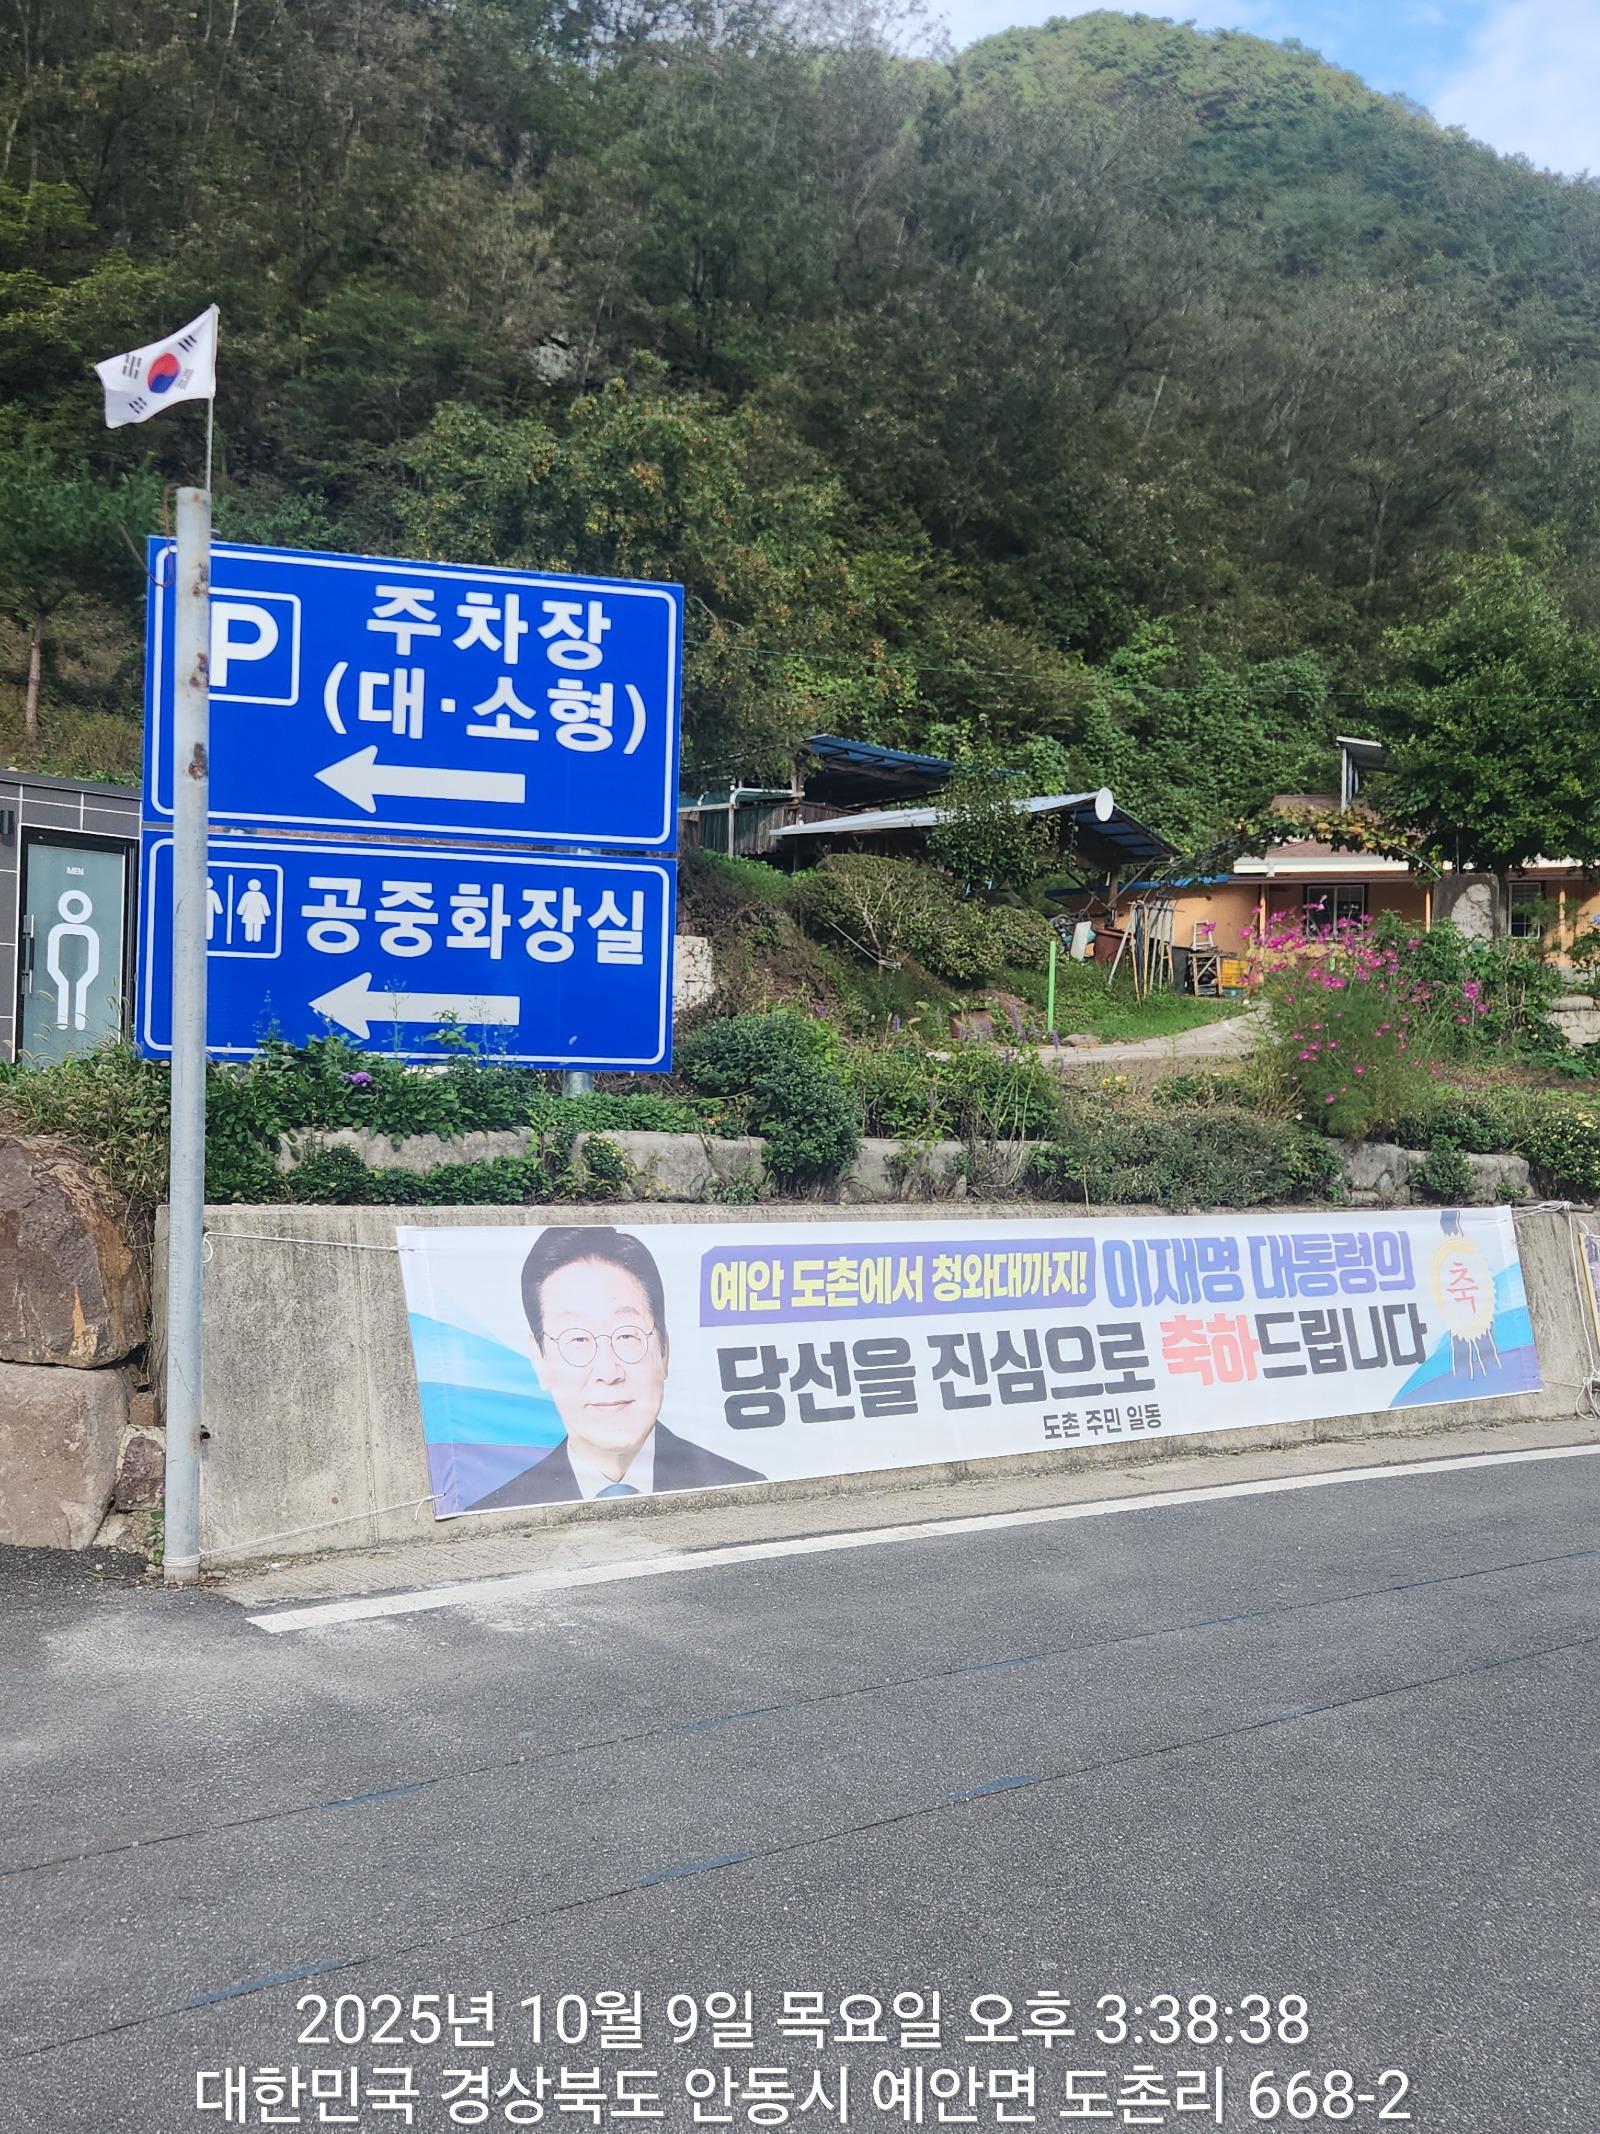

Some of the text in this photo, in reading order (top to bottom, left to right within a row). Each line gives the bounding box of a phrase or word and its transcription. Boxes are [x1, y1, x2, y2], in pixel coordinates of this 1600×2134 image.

[208, 601, 279, 687] P
[66, 866, 84, 876] MEN
[301, 876, 645, 966] 공중화장실
[710, 1230, 1416, 1312] 예안 도촌에서 청와대까지! 이재명 대통령의
[1446, 1261, 1479, 1314] 축
[717, 1302, 1427, 1431] 당선을 진심으로 축하드립니다
[1043, 1403, 1163, 1440] 도촌 주민 일동
